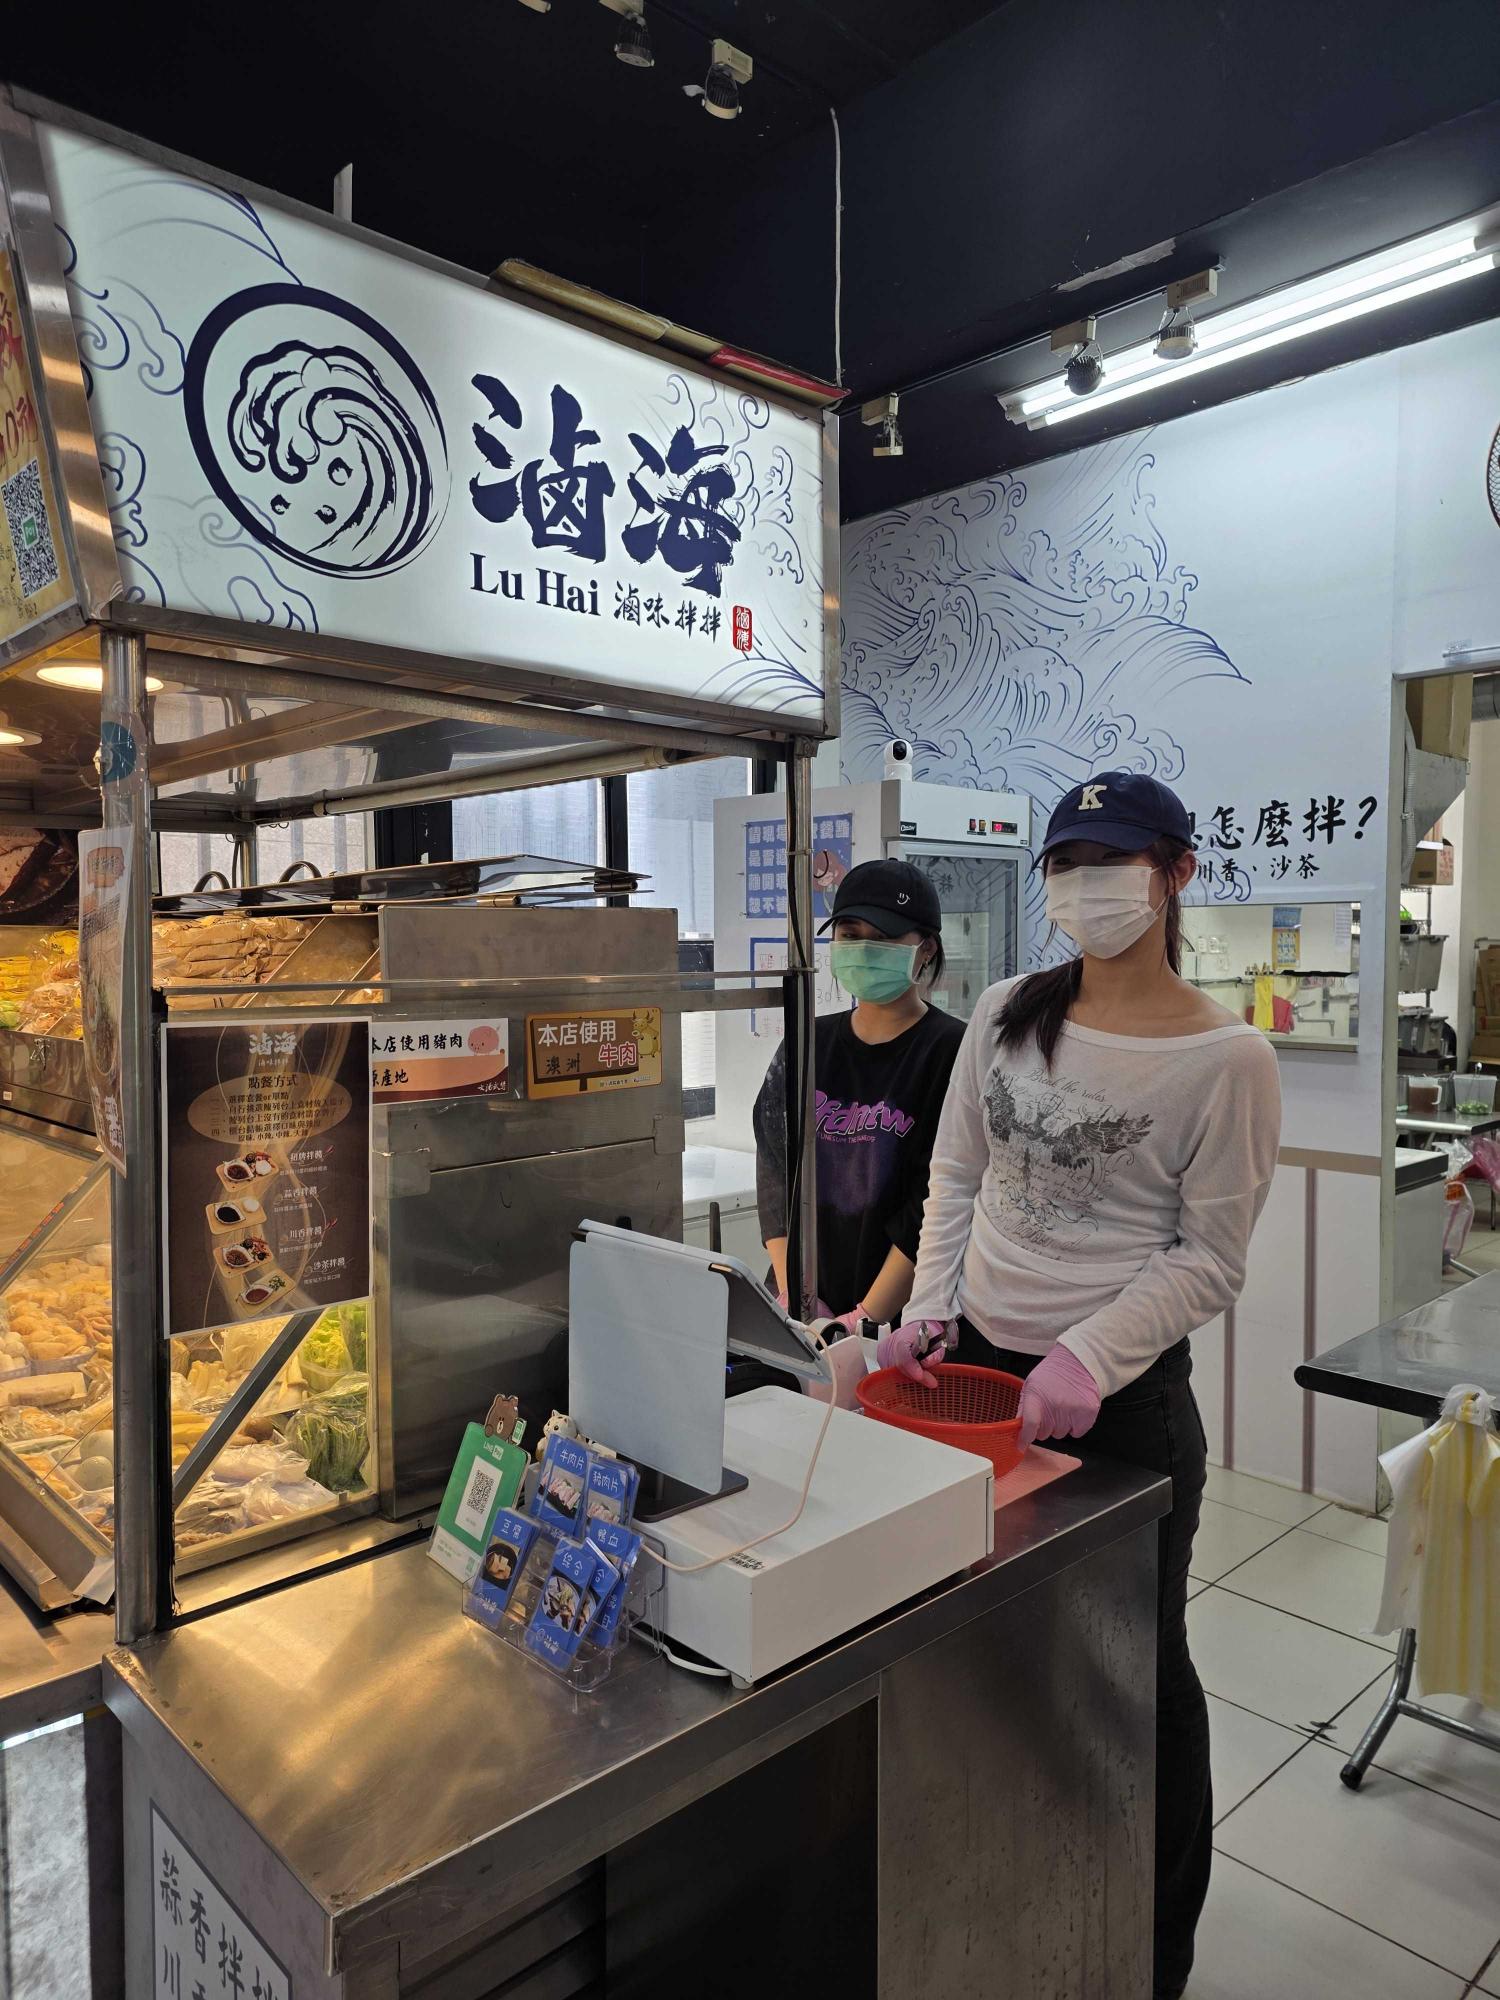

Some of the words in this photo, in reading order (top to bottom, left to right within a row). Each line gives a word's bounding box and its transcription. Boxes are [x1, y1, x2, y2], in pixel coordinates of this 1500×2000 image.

[469, 373, 742, 599] 滷海
[469, 552, 526, 601] Lu
[535, 567, 602, 617] Hai
[613, 580, 722, 643] 滷味拌拌
[1078, 784, 1107, 811] K
[537, 1019, 617, 1047] 本店使用
[546, 1052, 581, 1075] 澳洲
[598, 1041, 637, 1068] 牛肉
[248, 1074, 298, 1090] 點餐方式
[1061, 1080, 1081, 1094] the
[1082, 1087, 1107, 1103] rules
[559, 1448, 586, 1470] 牛肉片
[592, 1470, 619, 1494] 豬肉片
